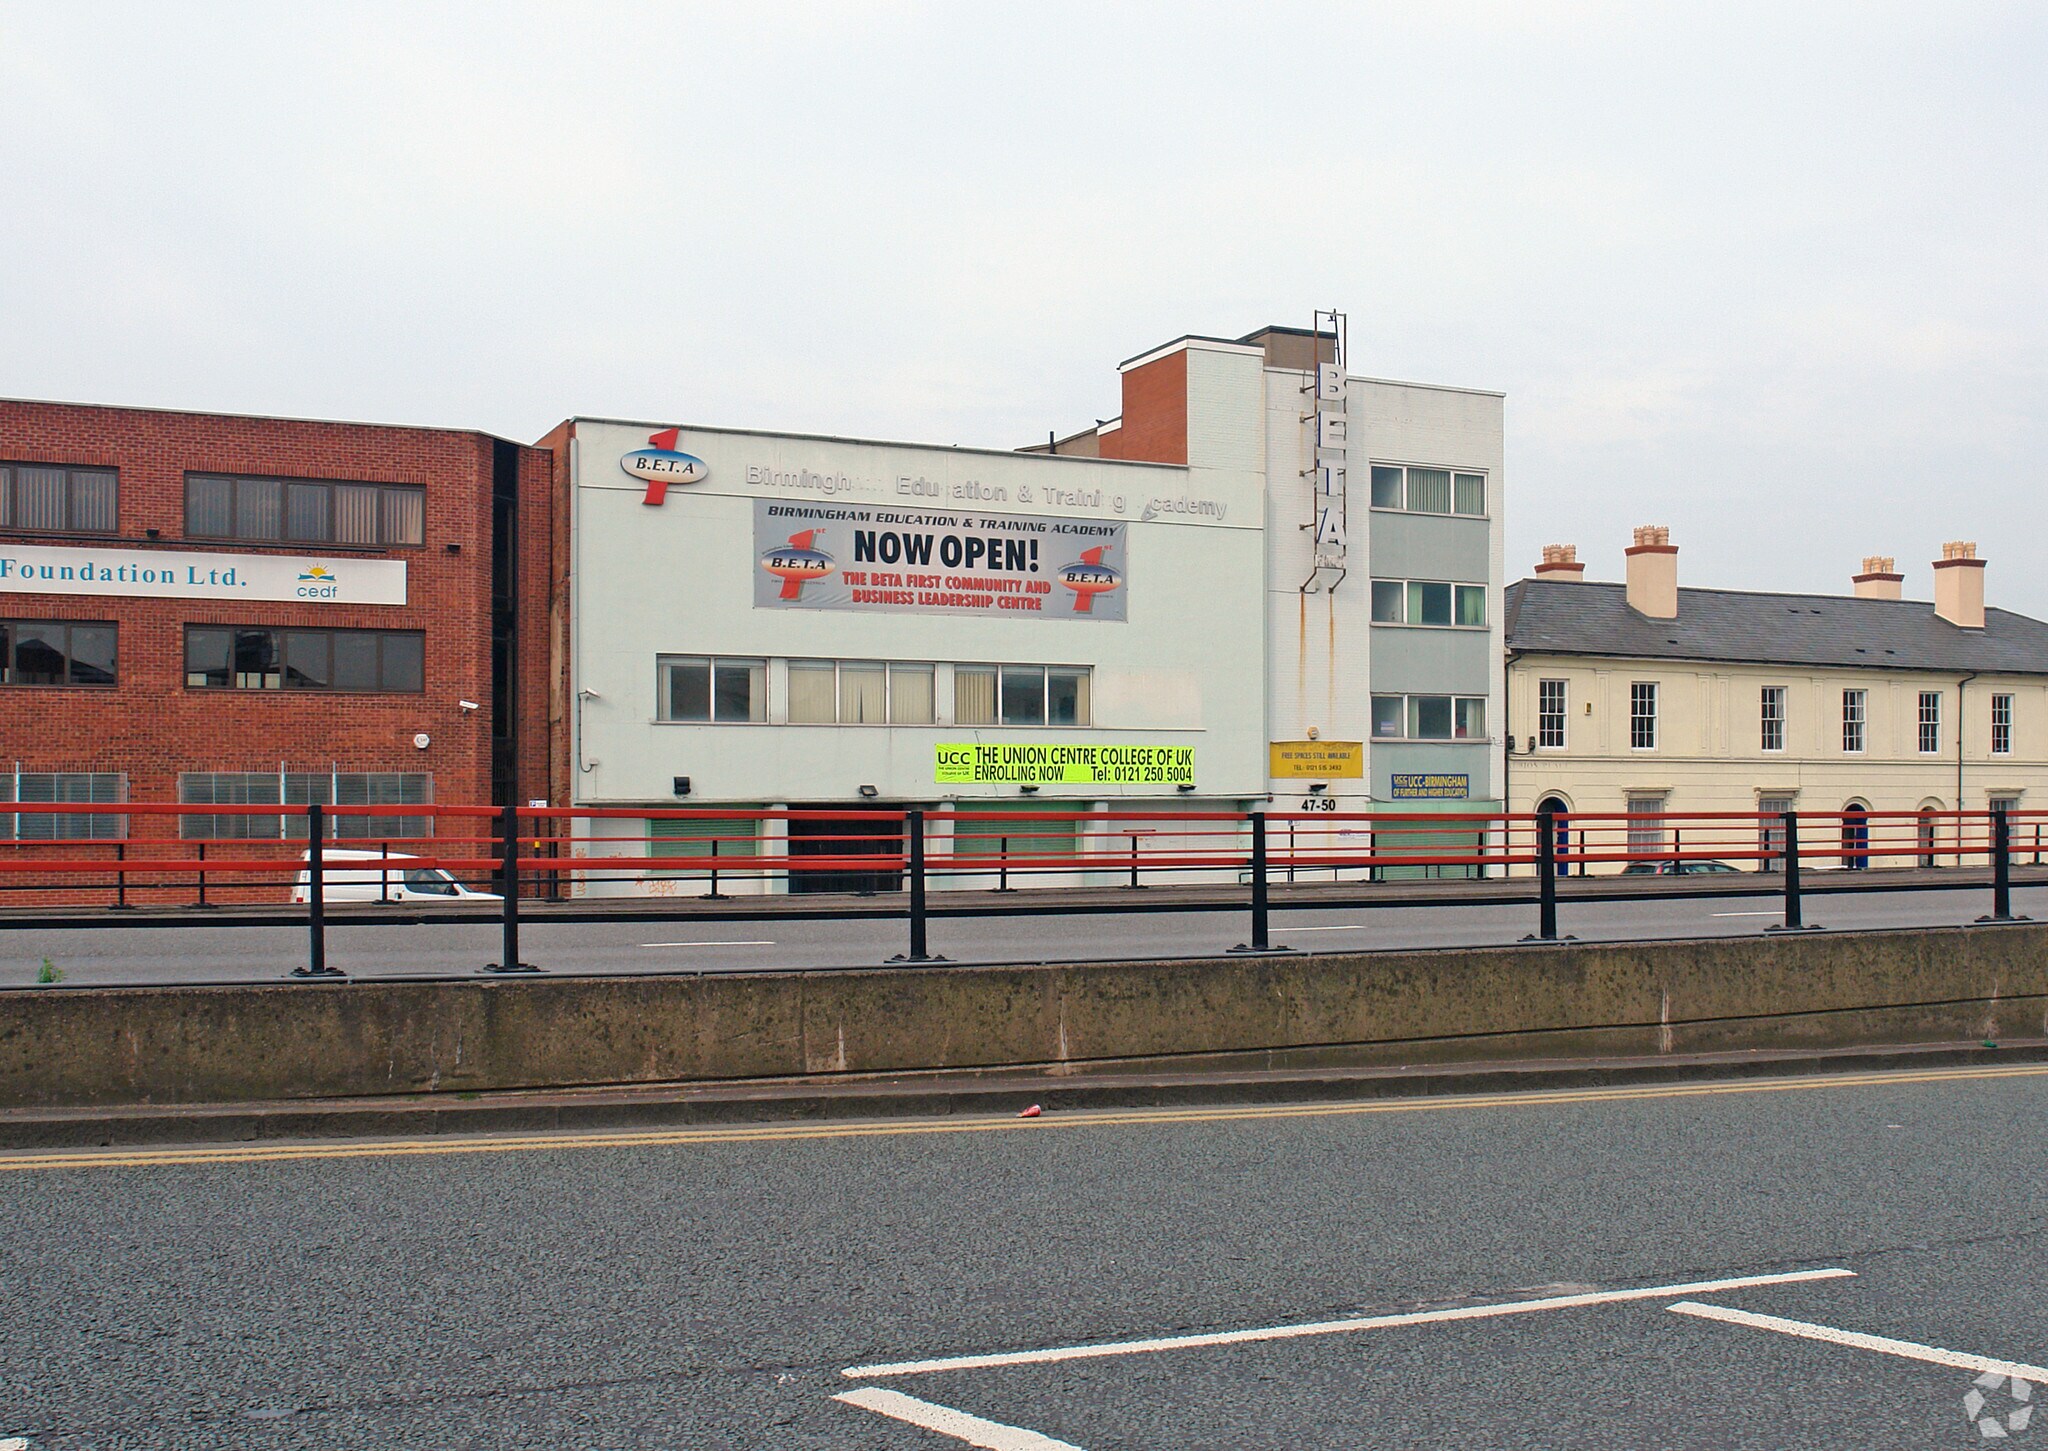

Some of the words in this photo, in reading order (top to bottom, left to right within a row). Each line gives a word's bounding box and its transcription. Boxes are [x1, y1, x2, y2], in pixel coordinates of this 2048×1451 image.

[1317, 362, 1347, 545] BETA
[636, 457, 695, 474] B.E.T.A
[1018, 484, 1032, 503] &
[1042, 487, 1126, 513] Trainig
[768, 506, 871, 522] BIRMINGHAM
[876, 513, 958, 527] EDUCATION
[962, 518, 973, 528] &
[979, 519, 1047, 532] TRAINING
[1051, 524, 1118, 537] ACADEMY
[854, 530, 934, 565] NOW
[940, 535, 1039, 572] OPEN!
[771, 558, 826, 569] B.E.T.A
[0, 559, 175, 585] Foundation
[187, 566, 247, 587] Ltd.
[1066, 572, 1113, 584] B.E.T.A
[297, 586, 338, 598] cedf
[842, 572, 867, 586] THE
[871, 573, 902, 587] BETA
[906, 574, 942, 589] FIRST
[945, 576, 1022, 592] COMMUNITY
[1025, 581, 1051, 594] AND
[852, 590, 914, 604] BUSINESS
[918, 591, 993, 608] LEADERSHIP
[997, 596, 1042, 611] CENTRE
[938, 752, 970, 764] UCC
[975, 747, 998, 764] THE
[1003, 747, 1047, 764] UNION
[1051, 747, 1096, 764] CENTRE
[1100, 748, 1153, 765] COLLEGE
[1157, 749, 1173, 765] OF
[1176, 749, 1193, 765] UK
[975, 765, 1036, 780] ENROLLING
[1039, 766, 1065, 780] NOW
[1091, 766, 1111, 781] Tel:
[1114, 767, 1140, 781] 0121
[1144, 767, 1163, 781] 250
[1167, 767, 1192, 781] 5004
[1301, 799, 1336, 811] 47-50
